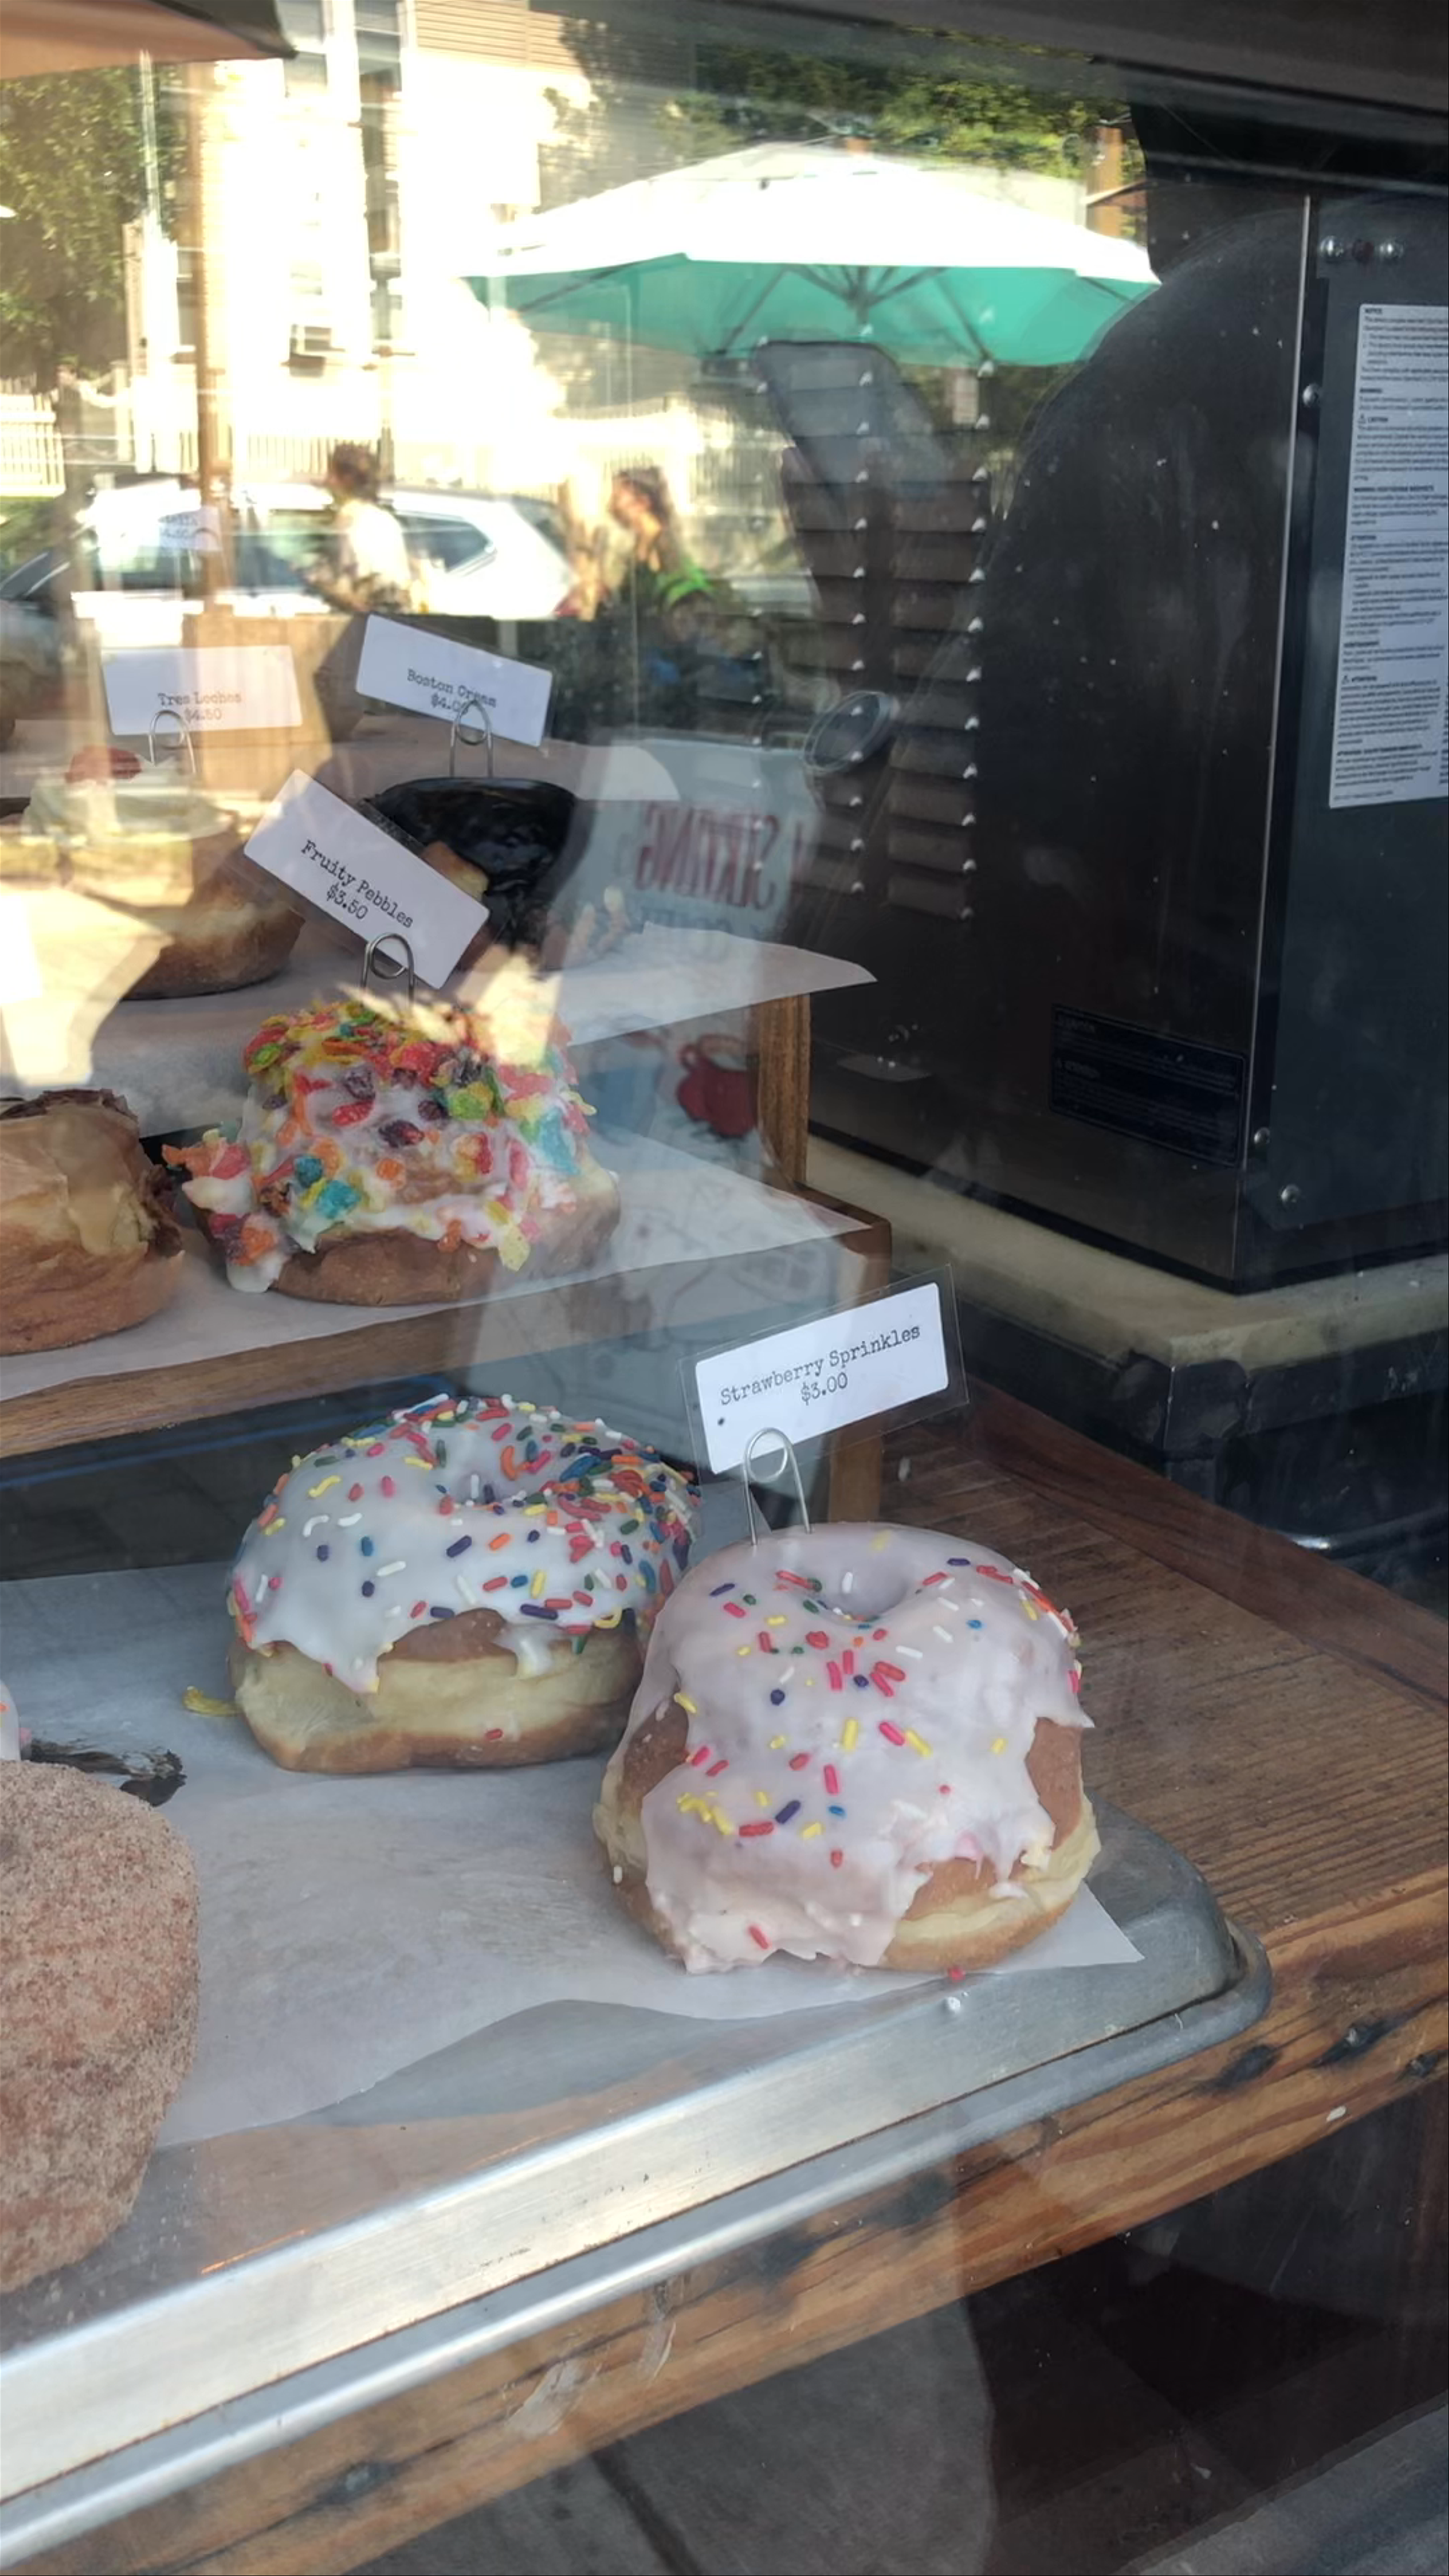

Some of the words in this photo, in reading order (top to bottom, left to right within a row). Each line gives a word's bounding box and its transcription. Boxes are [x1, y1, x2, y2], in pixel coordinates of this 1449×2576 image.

[407, 668, 453, 694] Boston
[157, 693, 191, 706] Tres
[301, 839, 356, 887] Fruity
[357, 879, 413, 929] Pebbles
[326, 882, 368, 920] $3.50
[720, 1358, 824, 1406] Strawberry
[829, 1325, 921, 1368] Sprinkles
[800, 1372, 848, 1405] $3.00
